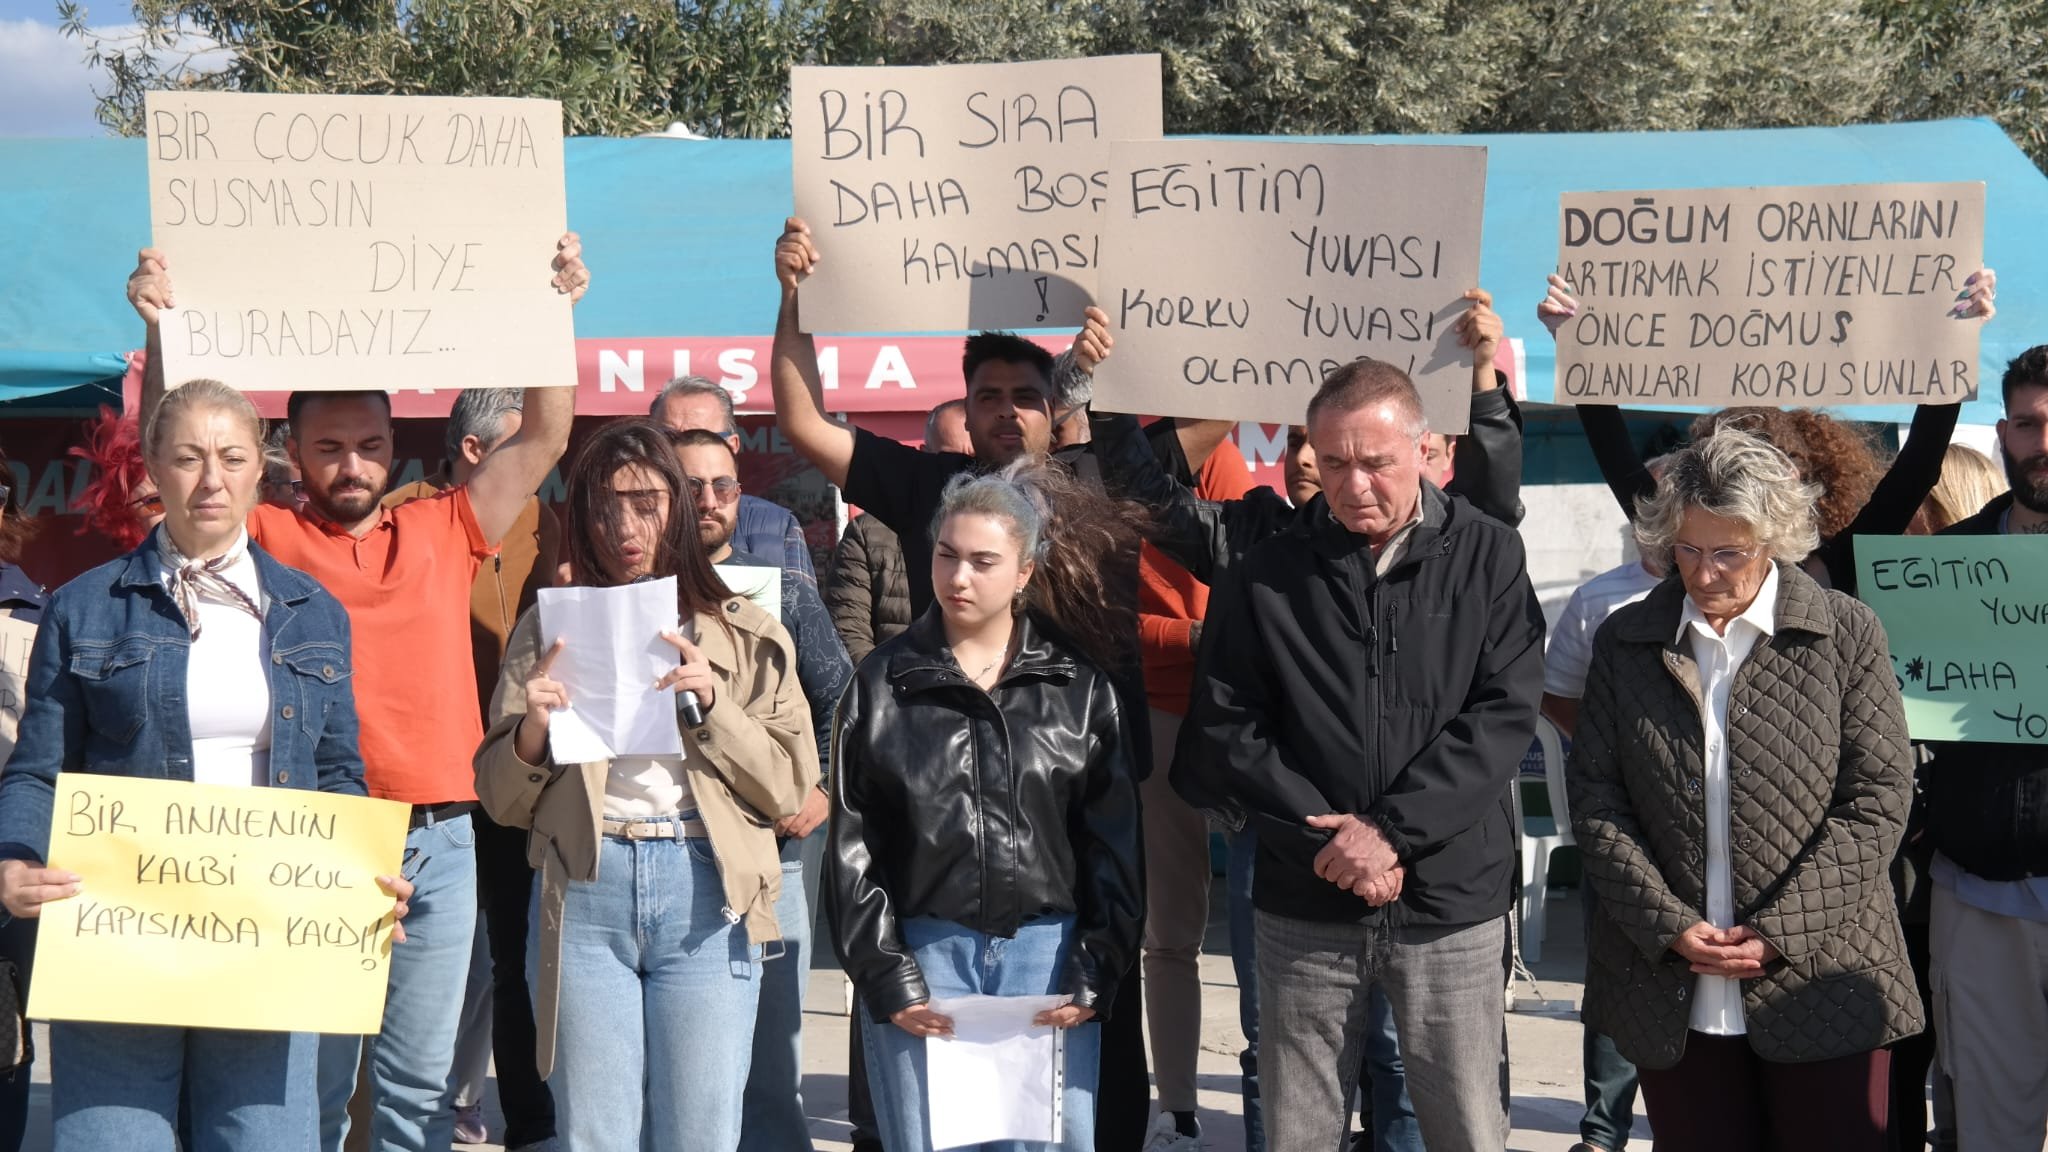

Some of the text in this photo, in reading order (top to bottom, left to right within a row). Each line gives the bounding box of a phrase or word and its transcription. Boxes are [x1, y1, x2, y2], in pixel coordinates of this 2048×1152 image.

[153, 102, 538, 168] BİR ÇOCUK DAHA
[820, 85, 1098, 161] BİR SIRA
[165, 178, 374, 228] SUSMASIN
[830, 177, 970, 228] DAHA
[1130, 160, 1325, 219] EĞİTİM
[1564, 197, 1959, 248] DOĞUM ORANLARINI
[369, 234, 483, 294] DİYE
[1290, 225, 1441, 280] YUVASI
[1564, 250, 1959, 298] ARTIRMAK İSTİYENLER
[1120, 288, 1435, 342] KORKU YUVASI
[1576, 305, 1667, 348] ÖNCE
[1564, 358, 1974, 398] OLANLARI KORUSUNLAR
[67, 790, 337, 841] BİR ANNENİN
[136, 853, 354, 889] KALBİ OKUL
[75, 901, 260, 948] KAPISINDA
